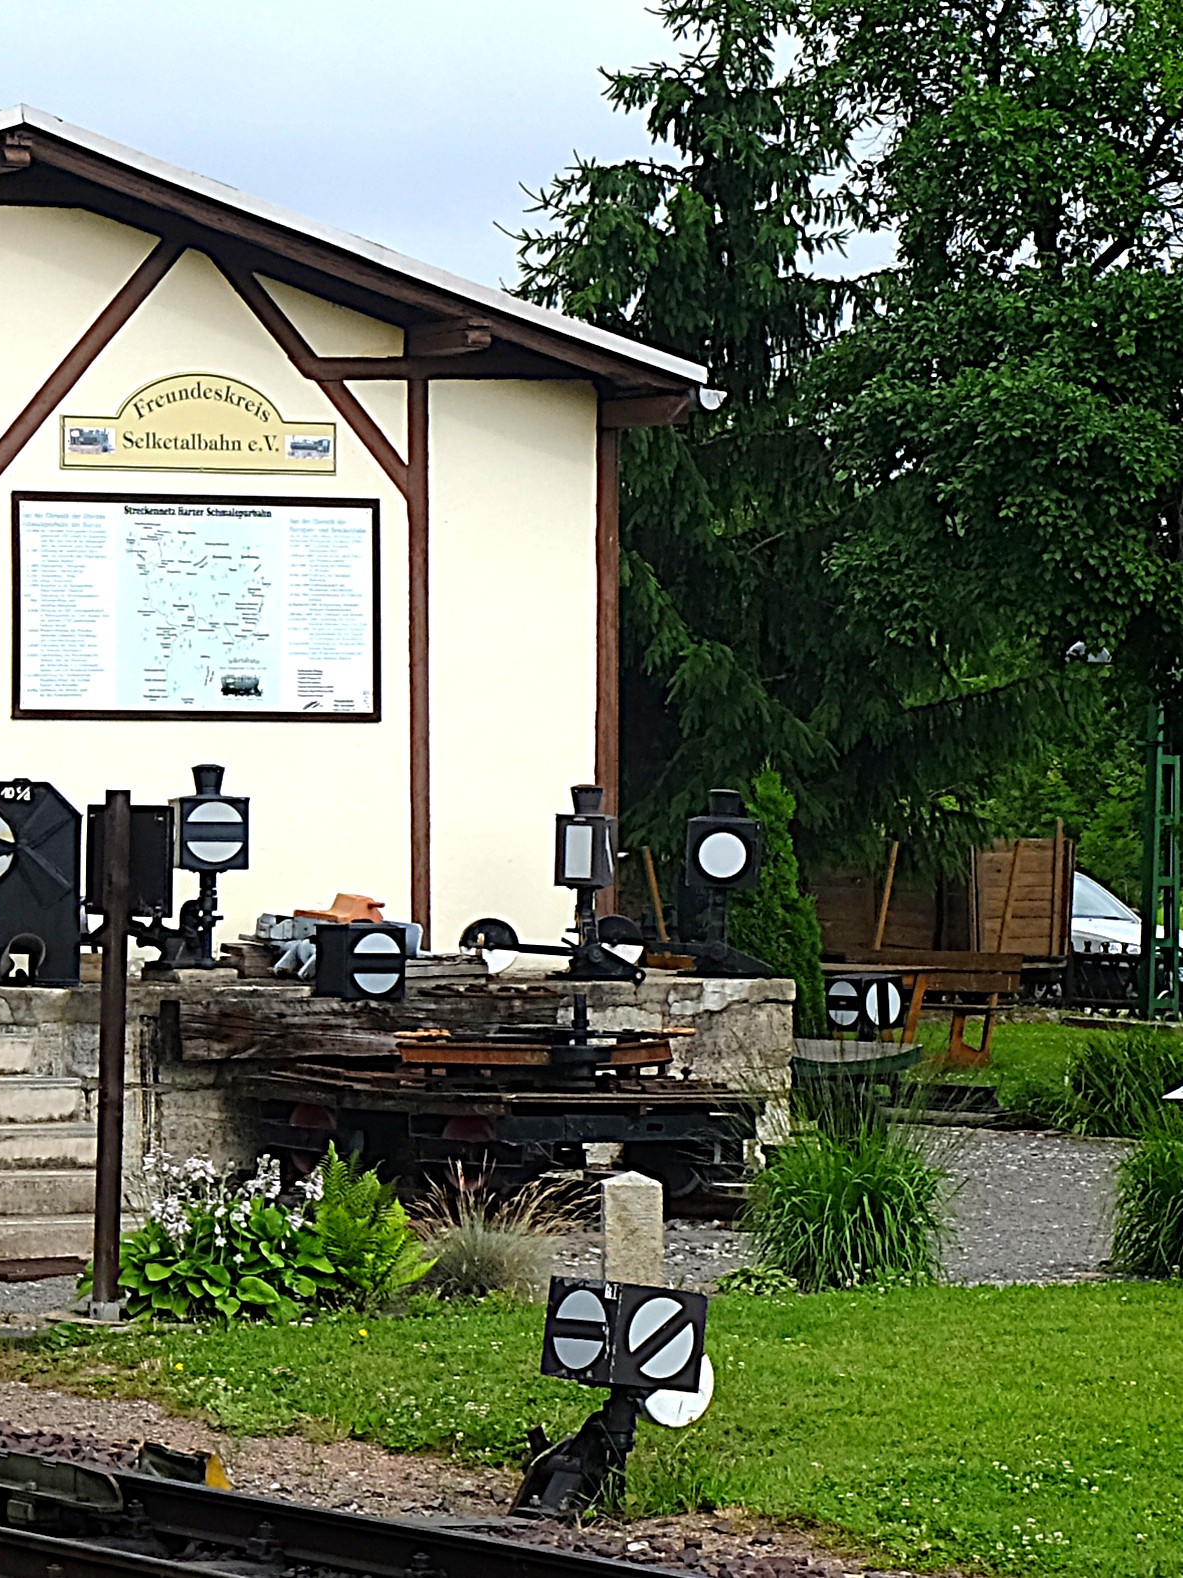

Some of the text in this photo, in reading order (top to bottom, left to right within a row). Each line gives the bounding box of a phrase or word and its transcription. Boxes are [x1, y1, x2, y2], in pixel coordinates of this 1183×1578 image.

[132, 381, 271, 423] Freundeskreis
[122, 430, 280, 452] Selketalbahn e.V.
